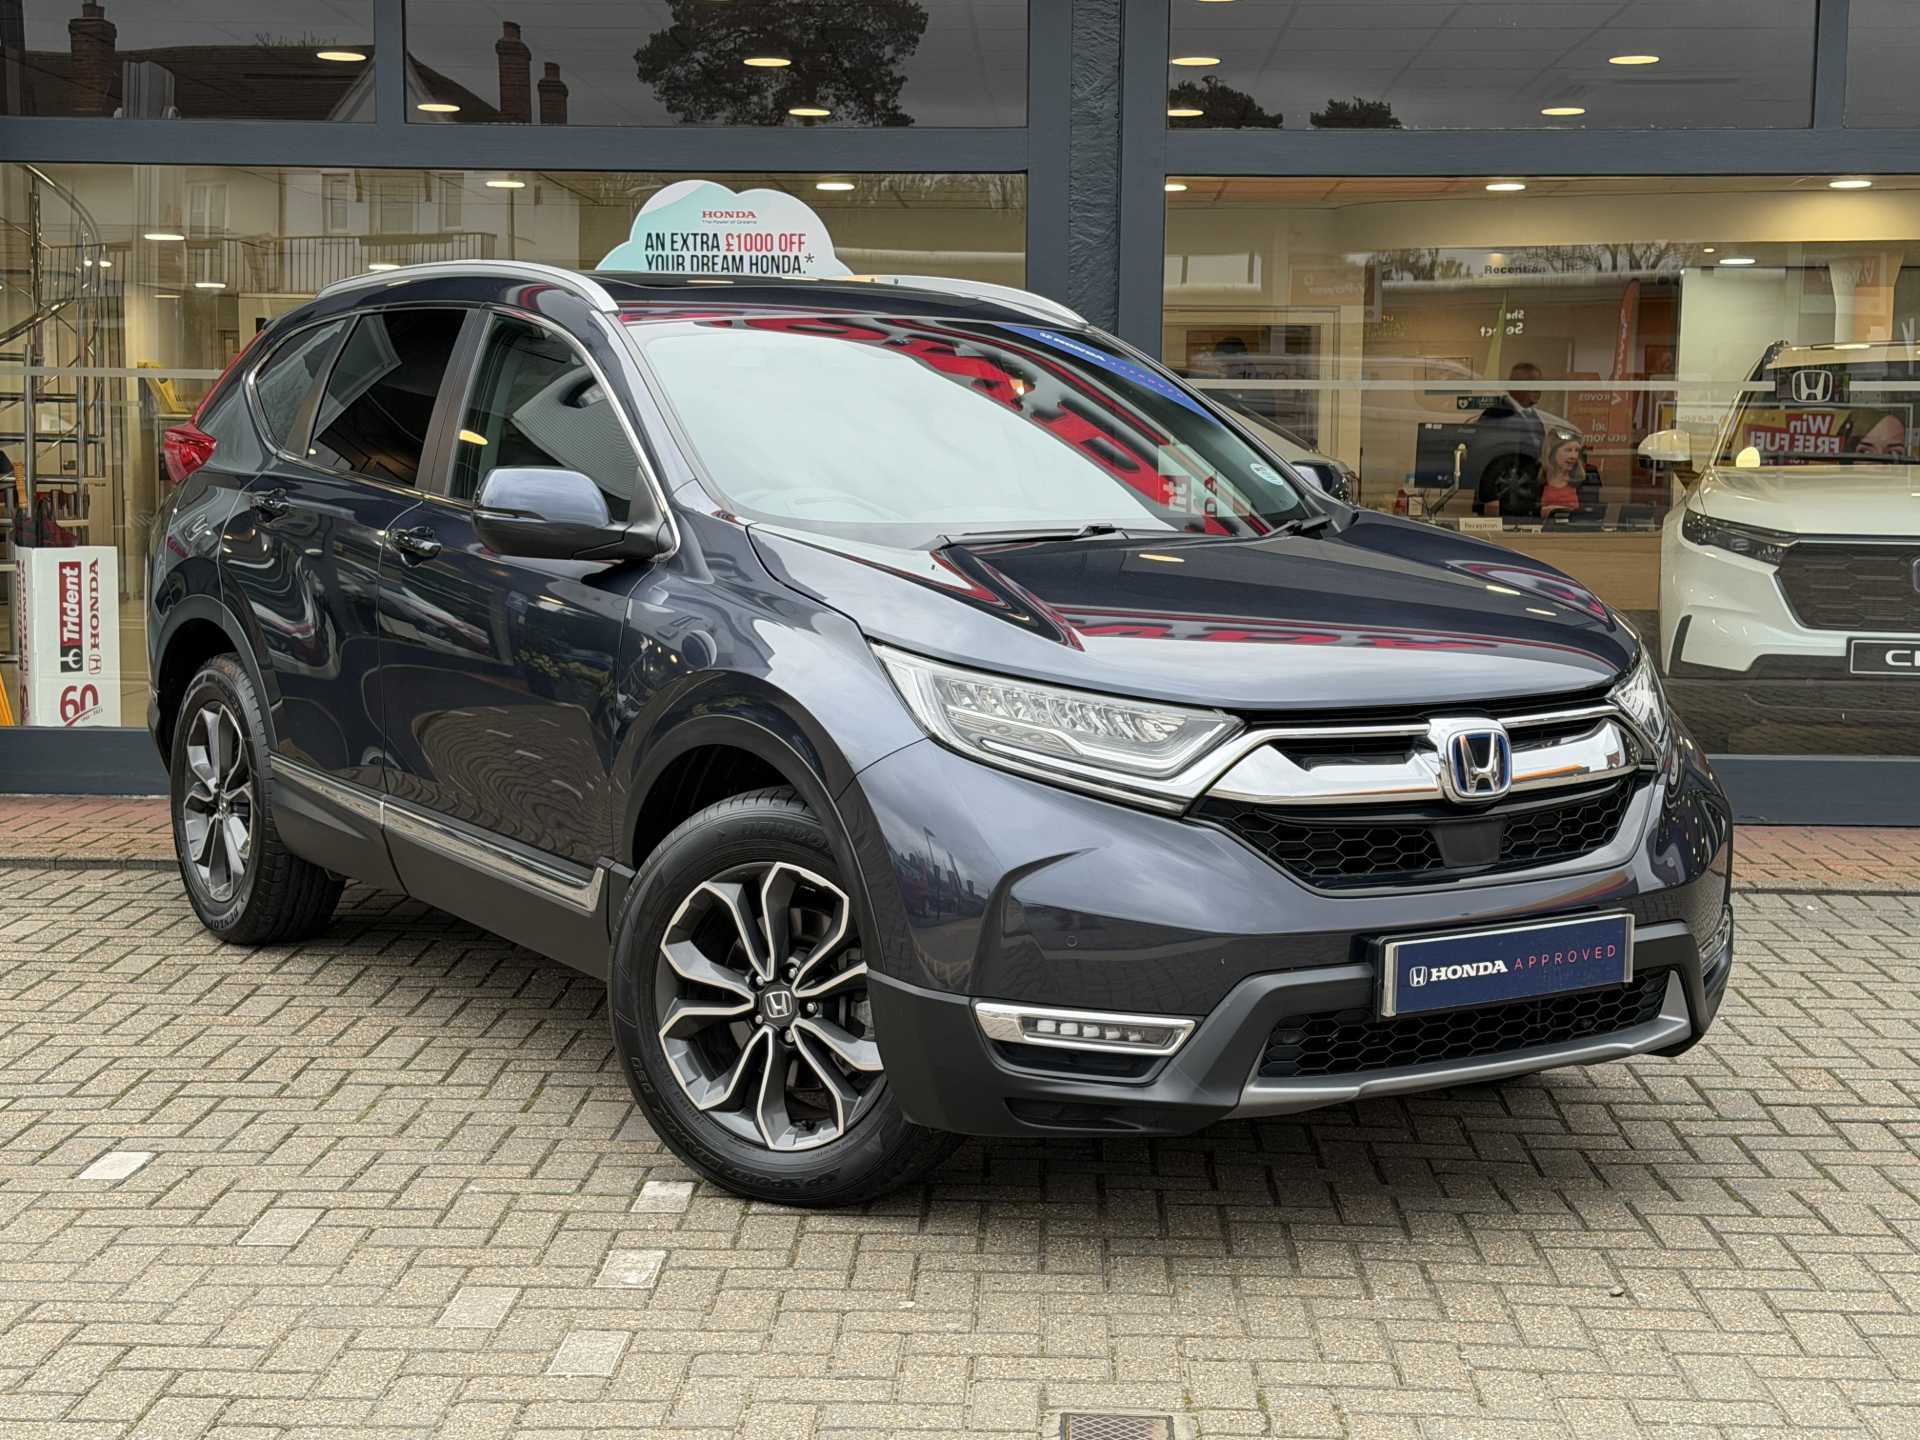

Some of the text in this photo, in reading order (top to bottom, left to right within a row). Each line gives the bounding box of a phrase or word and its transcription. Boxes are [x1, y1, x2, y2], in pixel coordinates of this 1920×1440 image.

[702, 210, 757, 219] HONDA
[645, 232, 807, 253] AN EXTRA £1000 OFF
[645, 254, 686, 272] YOUR
[690, 254, 745, 274] DREAM
[61, 566, 81, 643] Trident
[89, 557, 101, 650] HONDA
[1885, 650, 1920, 667] C
[1430, 943, 1617, 982] HONDA APPROVED
